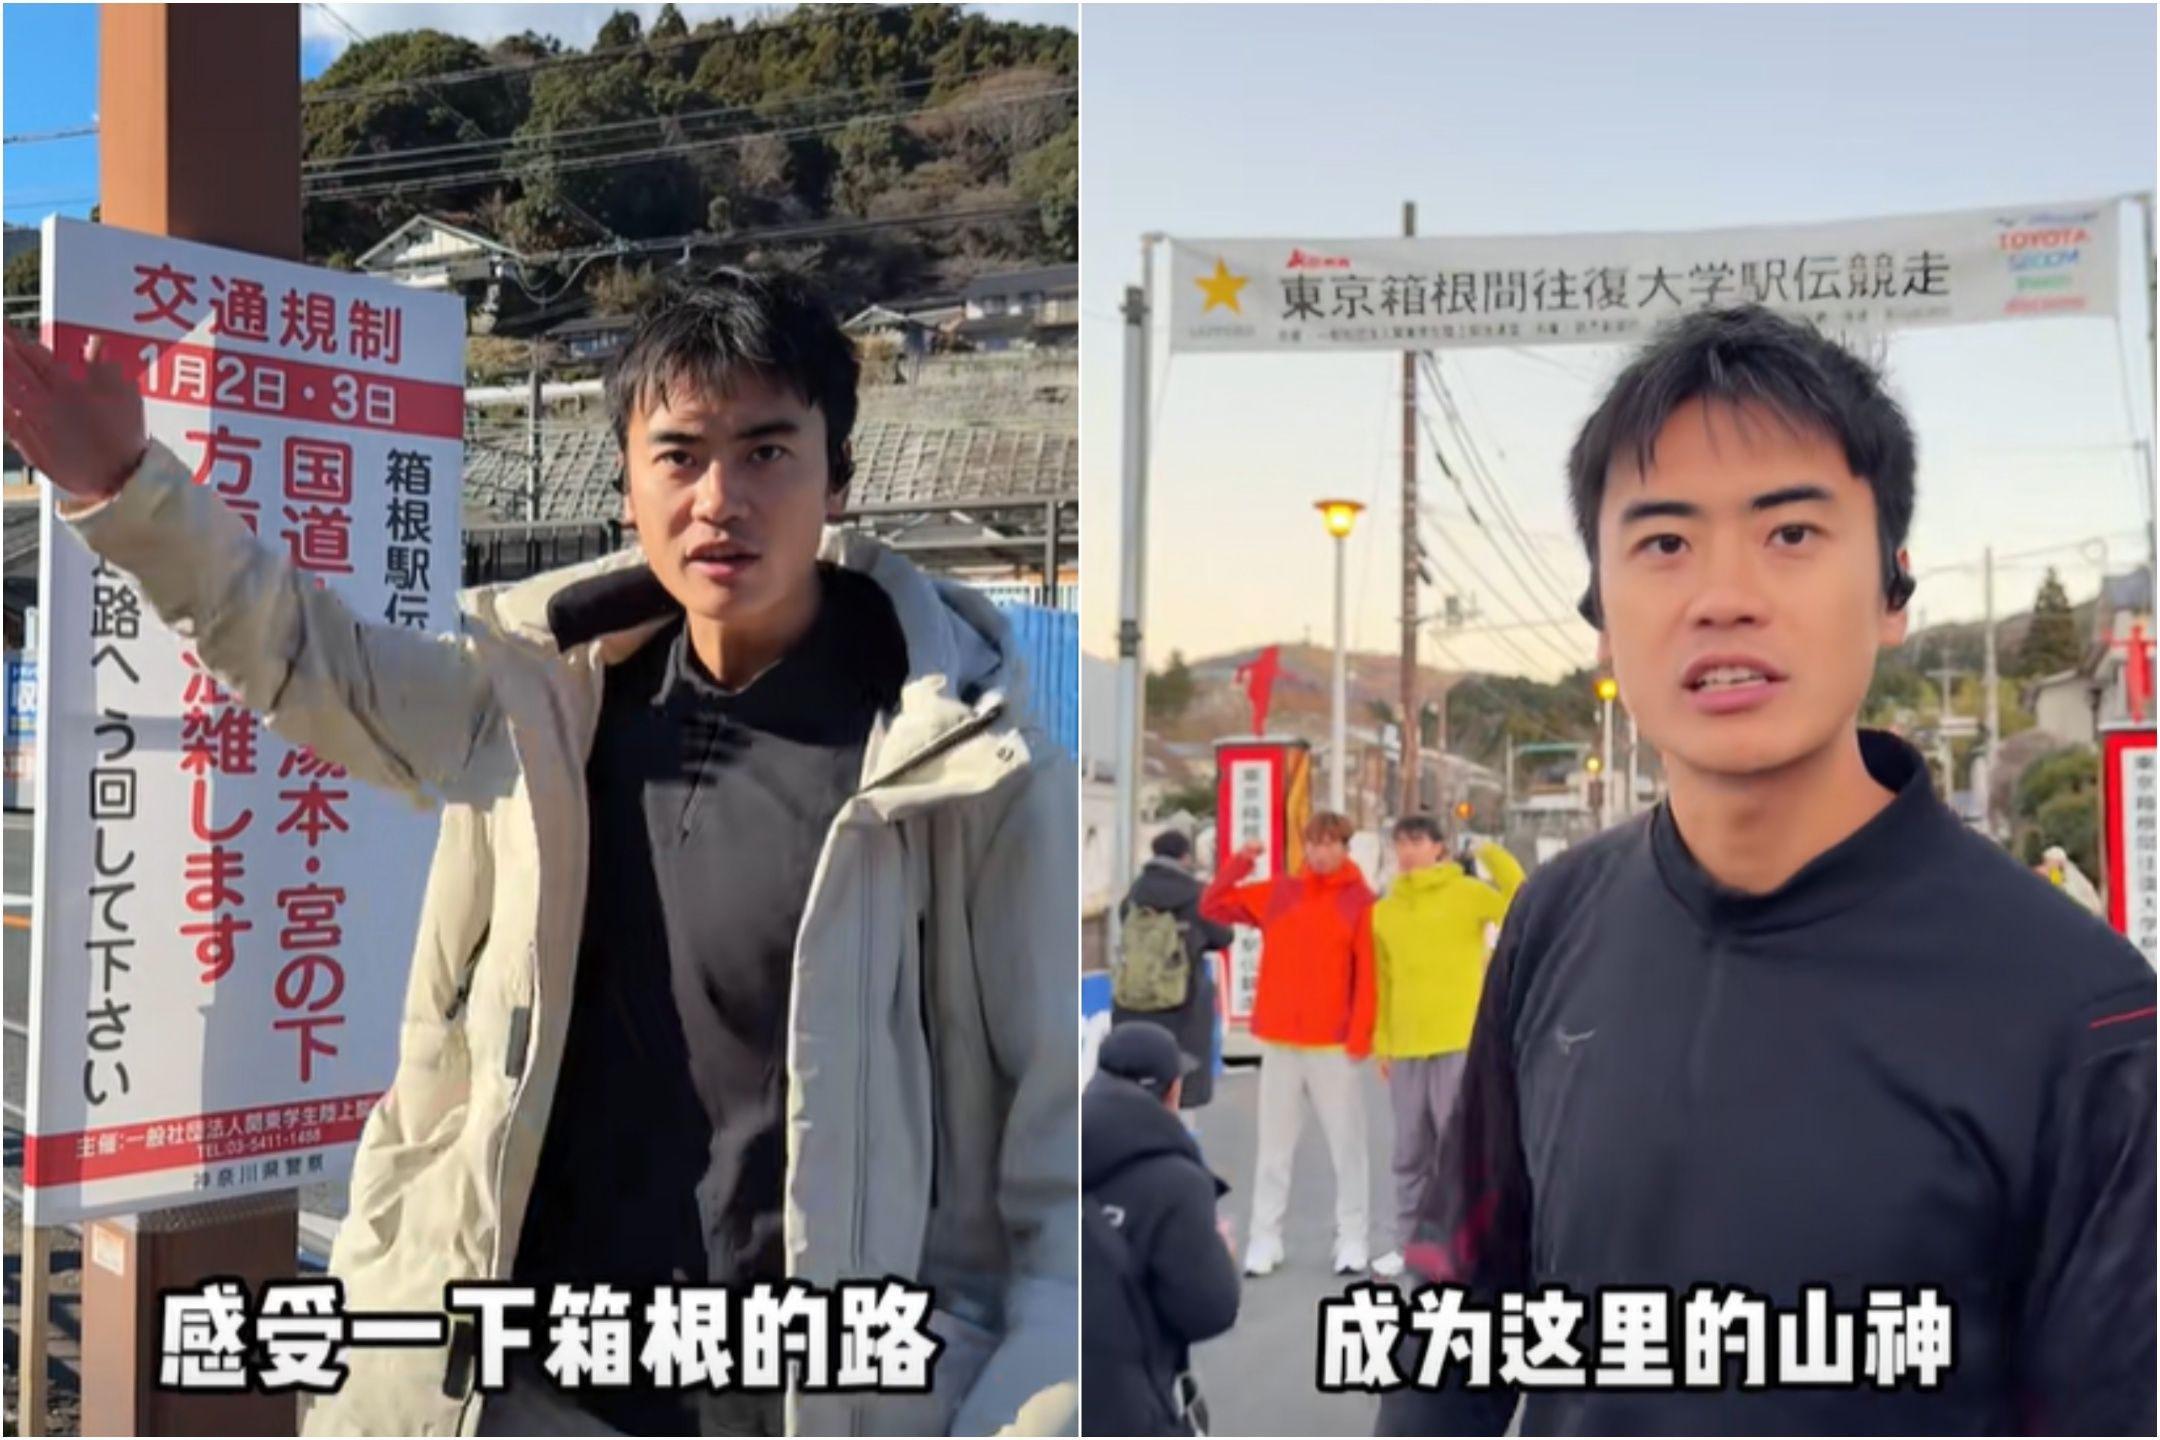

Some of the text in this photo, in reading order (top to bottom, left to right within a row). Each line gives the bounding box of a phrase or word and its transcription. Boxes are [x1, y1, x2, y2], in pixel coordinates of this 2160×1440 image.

[1279, 250, 1951, 322] 東京箱根間往復大学駅伝競走
[1997, 228, 2092, 251] TOYOTA
[133, 262, 402, 365] 交通規制
[138, 342, 396, 426] 1月2日・3日
[384, 447, 432, 630] 箱根駅伝
[83, 708, 136, 1106] う回して下さい
